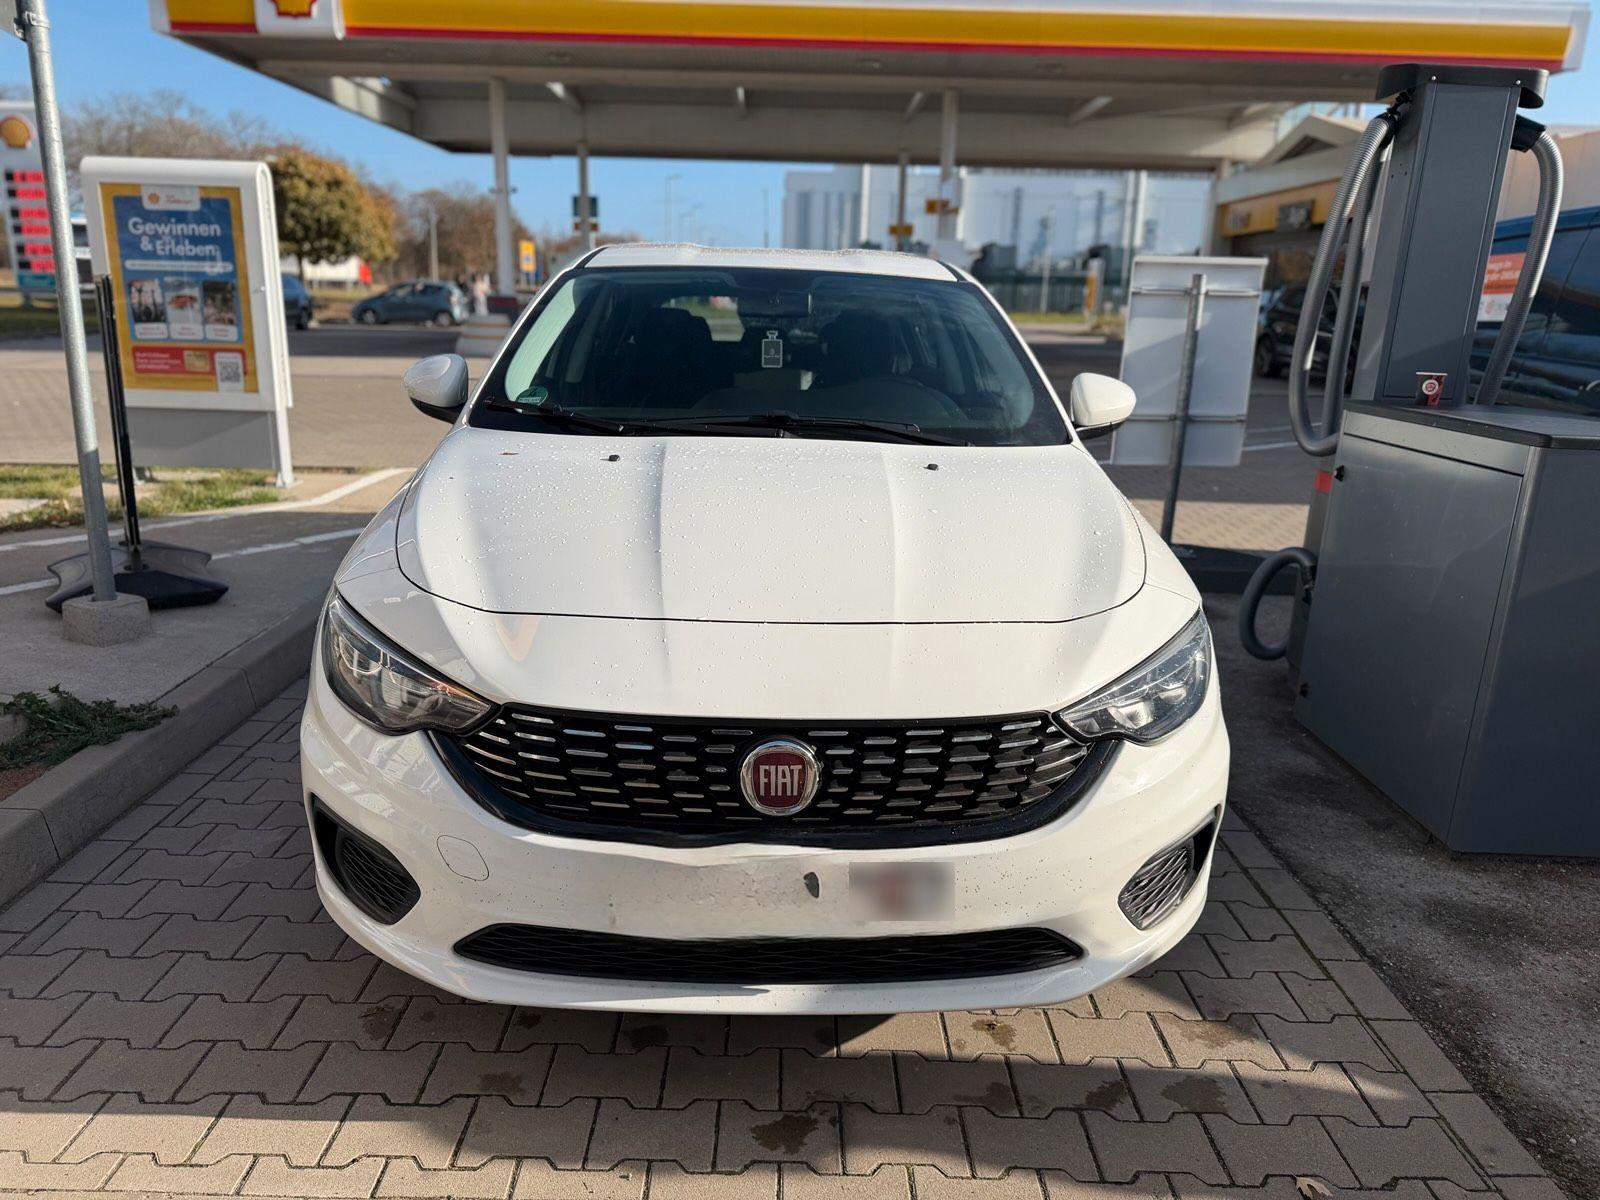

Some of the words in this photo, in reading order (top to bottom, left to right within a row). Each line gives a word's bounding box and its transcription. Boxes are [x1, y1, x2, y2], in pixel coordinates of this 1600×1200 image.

[128, 217, 222, 236] Gewinnen
[140, 236, 153, 251] &
[155, 239, 218, 256] Erleben
[760, 765, 802, 796] FIAT
